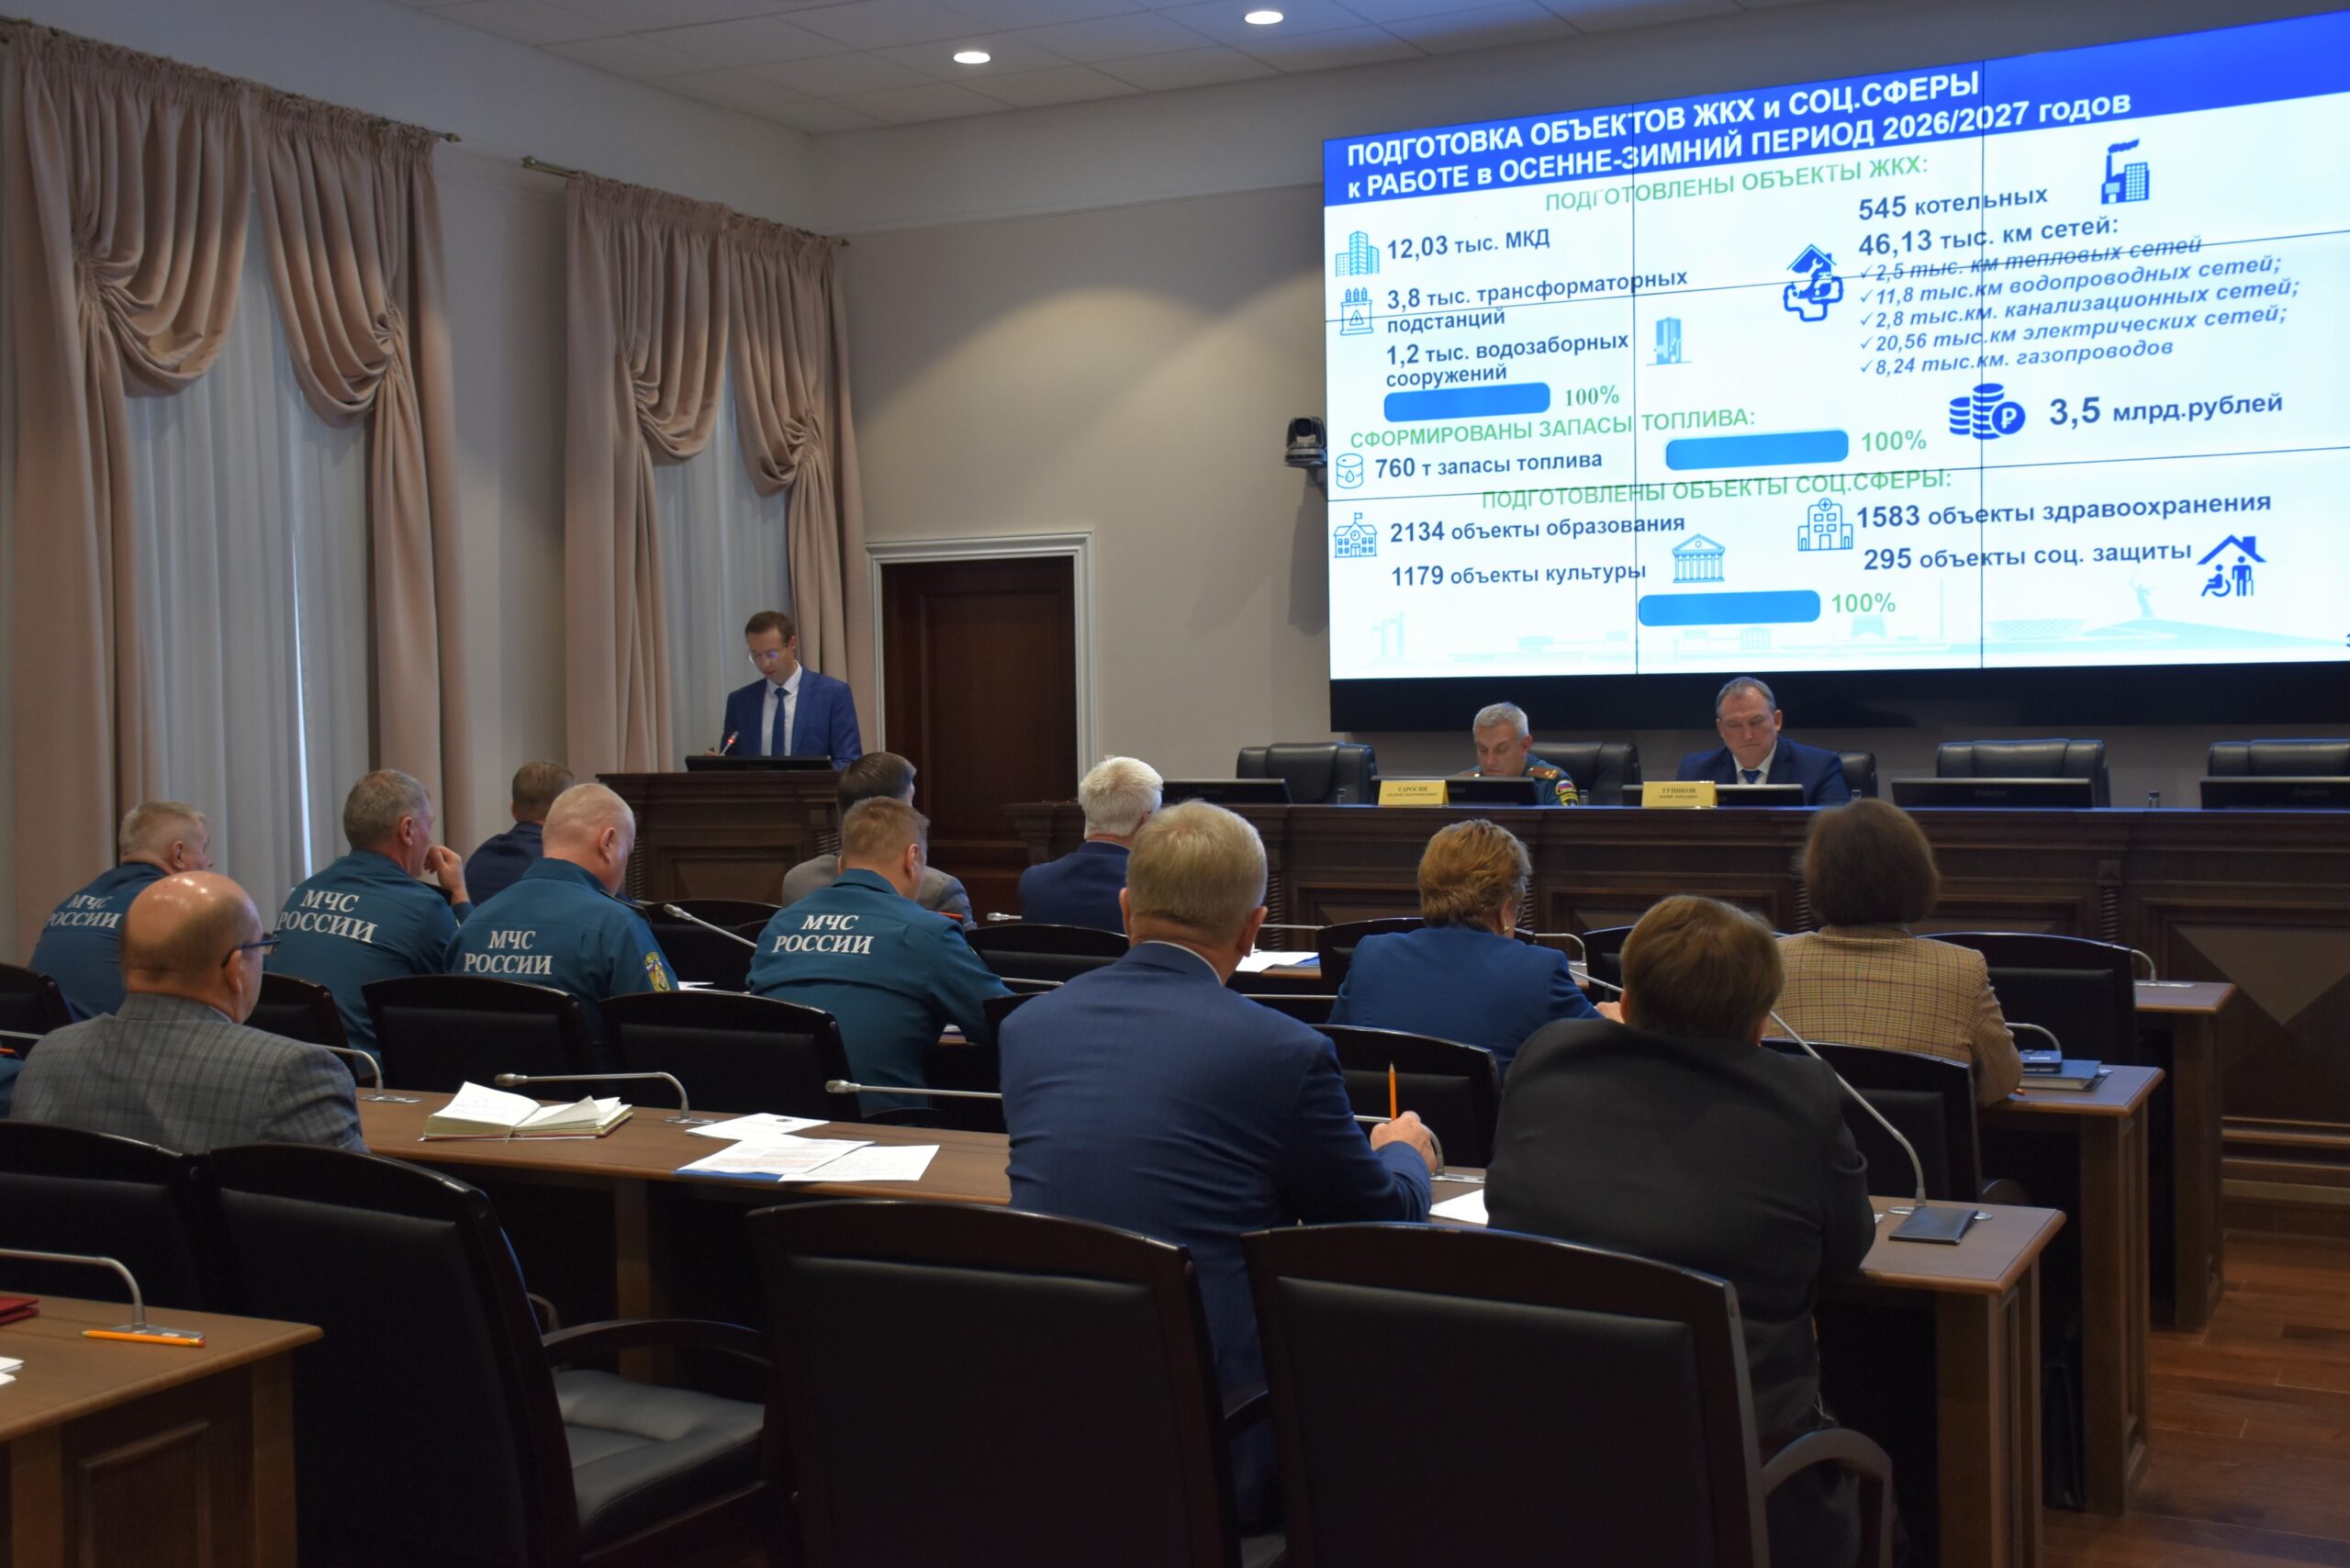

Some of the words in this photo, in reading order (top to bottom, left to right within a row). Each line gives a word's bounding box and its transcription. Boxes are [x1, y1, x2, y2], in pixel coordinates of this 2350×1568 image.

[1348, 126, 1524, 166] ПОДГОТОВКА
[1530, 106, 1685, 146] ОБЪЕКТОВ
[1694, 98, 1755, 127] ЖКХ
[1763, 100, 1780, 119] и
[1789, 71, 1979, 115] СОЦ.СФЕРЫ
[1348, 181, 1360, 199] к
[1368, 165, 1469, 196] РАБОТЕ
[1478, 167, 1492, 185] в
[1499, 129, 1742, 183] ОСЕННЕ-ЗИМНИЙ
[1751, 119, 1874, 155] ПЕРИОД
[1882, 101, 2030, 140] 2026/2027
[2039, 94, 2132, 123] годов
[1546, 175, 1734, 211] ПОДГОТОВЛЕНЫ
[1742, 162, 1862, 191] ОБЪЕКТЫ
[1869, 156, 1929, 178] ЖКХ:
[1859, 196, 1907, 220] 545
[1915, 188, 2049, 216] котельных
[1387, 235, 1449, 262] 12,03
[1455, 235, 1499, 254] тыс.
[1505, 229, 1550, 250] МКД
[1859, 230, 1932, 258] 46,13
[1940, 230, 1995, 250] тыс.
[2003, 227, 2032, 243] км
[2041, 216, 2119, 240] сетей:
[1876, 263, 1904, 283] 2,5
[1910, 261, 1964, 279] тыс.
[1971, 257, 1998, 274] км
[2005, 245, 2123, 270] тепловых
[2130, 235, 2203, 259] сетей
[1387, 288, 1420, 313] 3,8
[1427, 289, 1471, 307] тыс.
[1477, 272, 1688, 304] трансформаторных
[1876, 286, 1914, 307] 11,8
[1920, 283, 2003, 302] тыс.км
[2009, 265, 2192, 294] водопроводных
[2199, 254, 2282, 278] сетей;
[1387, 307, 1505, 333] подстанций
[1876, 311, 1904, 330] 2,8
[1910, 307, 1998, 326] тыс.км.
[2005, 288, 2210, 319] канализационных
[2216, 278, 2300, 300] сетей;
[1876, 333, 1927, 353] 20,56
[1933, 329, 2016, 348] тыс.км
[2023, 314, 2198, 341] электрических
[2205, 304, 2288, 327] сетей;
[1386, 344, 1419, 369] 1,2
[1426, 345, 1470, 364] тыс.
[1476, 334, 1629, 361] водозаборных
[1876, 357, 1916, 377] 8,24
[1922, 353, 2009, 373] тыс.км.
[2017, 340, 2174, 364] газопроводов
[1386, 364, 1507, 389] сооружений
[1565, 385, 1620, 407] 100%
[2049, 397, 2101, 431] 3,5
[2113, 393, 2283, 424] млрд.рублей
[1350, 421, 1532, 449] СФОРМИРОВАНЫ
[1539, 415, 1632, 439] ЗАПАСЫ
[1642, 409, 1756, 431] ТОПЛИВА:
[1861, 430, 1927, 453] 100%
[1376, 457, 1416, 479] 760
[1422, 462, 1431, 476] т
[1438, 459, 1511, 476] запасы
[1516, 453, 1603, 473] топлива
[1482, 483, 1665, 511] ПОДГОТОВЛЕНЫ
[1673, 476, 1788, 500] ОБЪЕКТЫ
[1796, 469, 1952, 495] СОЦ.СФЕРЫ:
[1857, 505, 1920, 529] 1583
[1928, 505, 2035, 526] объекты
[2042, 494, 2272, 524] здравоохранения
[1391, 521, 1445, 543] 2134
[1451, 521, 1539, 541] объекты
[1547, 516, 1685, 537] образования
[1863, 548, 1913, 570] 295
[1919, 550, 2026, 569] объекты
[2033, 548, 2085, 568] соц.
[2092, 543, 2192, 566] защиты
[1391, 566, 1444, 588] 1179
[1450, 566, 1539, 585] объекты
[1546, 565, 1647, 587] культуры
[1831, 592, 1897, 614] 100%
[299, 890, 360, 913] МЧС
[275, 911, 378, 944] РОССИИ
[800, 914, 859, 931] МЧС
[487, 930, 536, 950] МЧС
[772, 935, 874, 955] РОССИИ
[464, 954, 553, 975] РОССИИ
